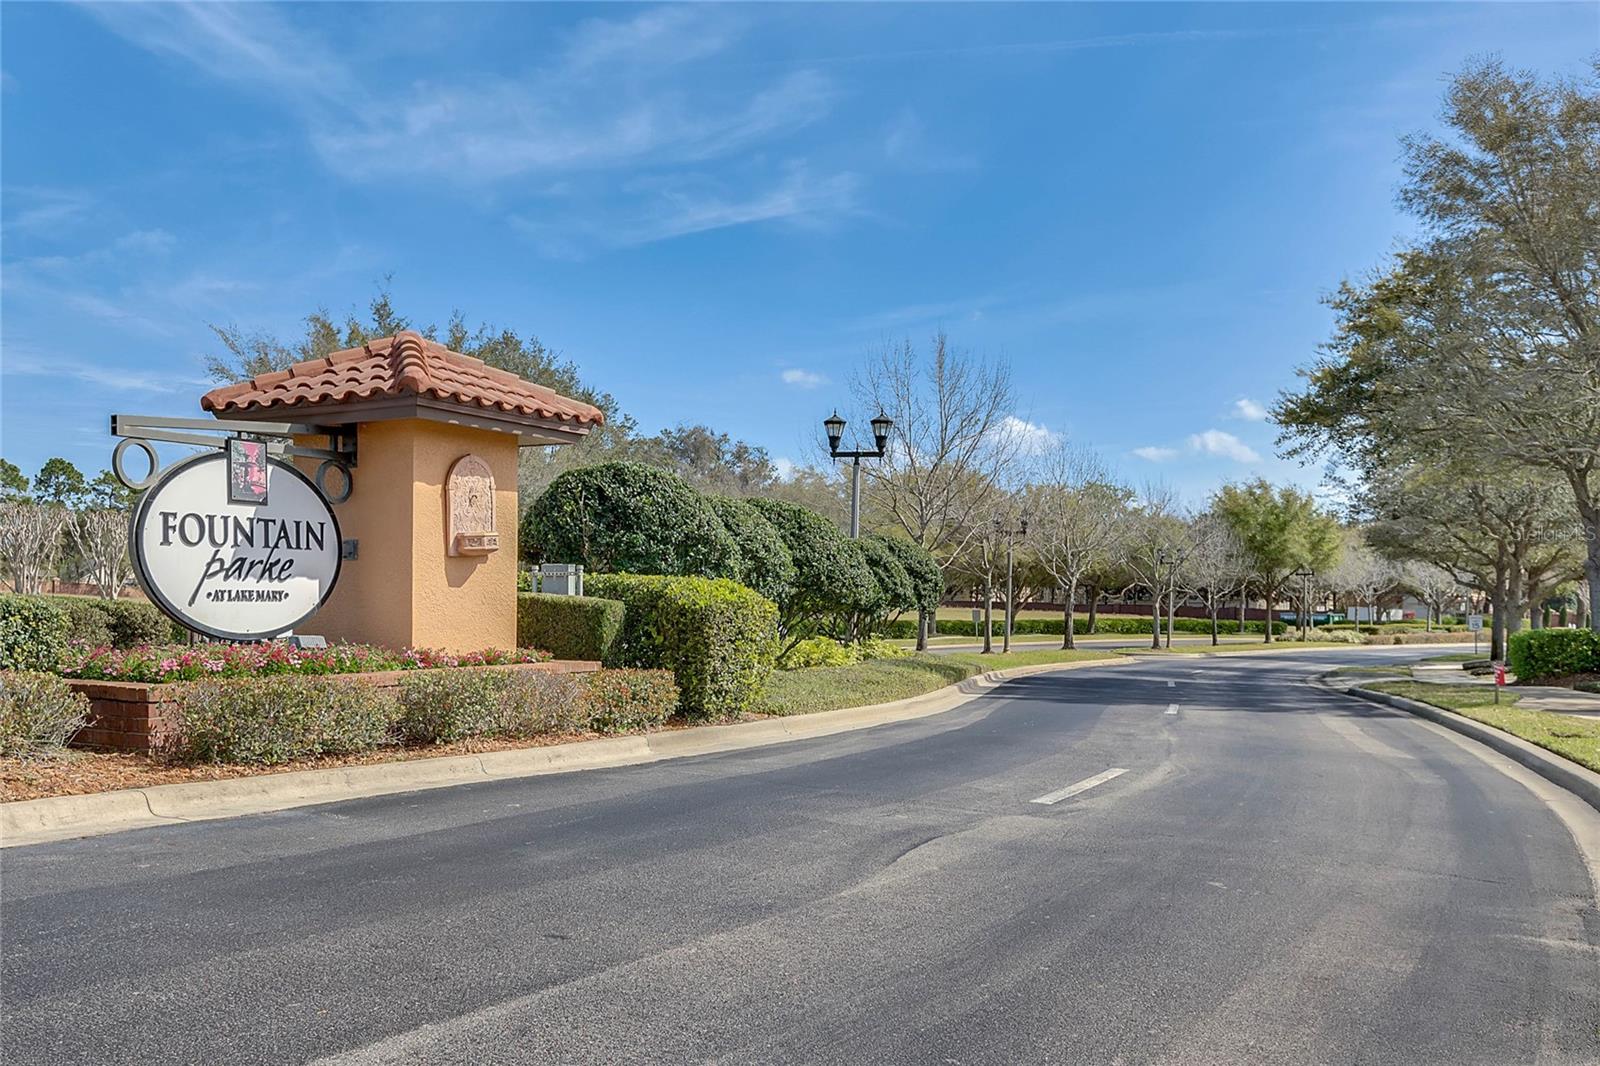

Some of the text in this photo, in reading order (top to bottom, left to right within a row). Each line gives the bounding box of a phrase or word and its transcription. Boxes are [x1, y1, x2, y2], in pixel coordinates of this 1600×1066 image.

[159, 511, 326, 551] FOUNTAIN
[188, 545, 295, 607] parke
[211, 589, 285, 602] AT LAKE MARY
